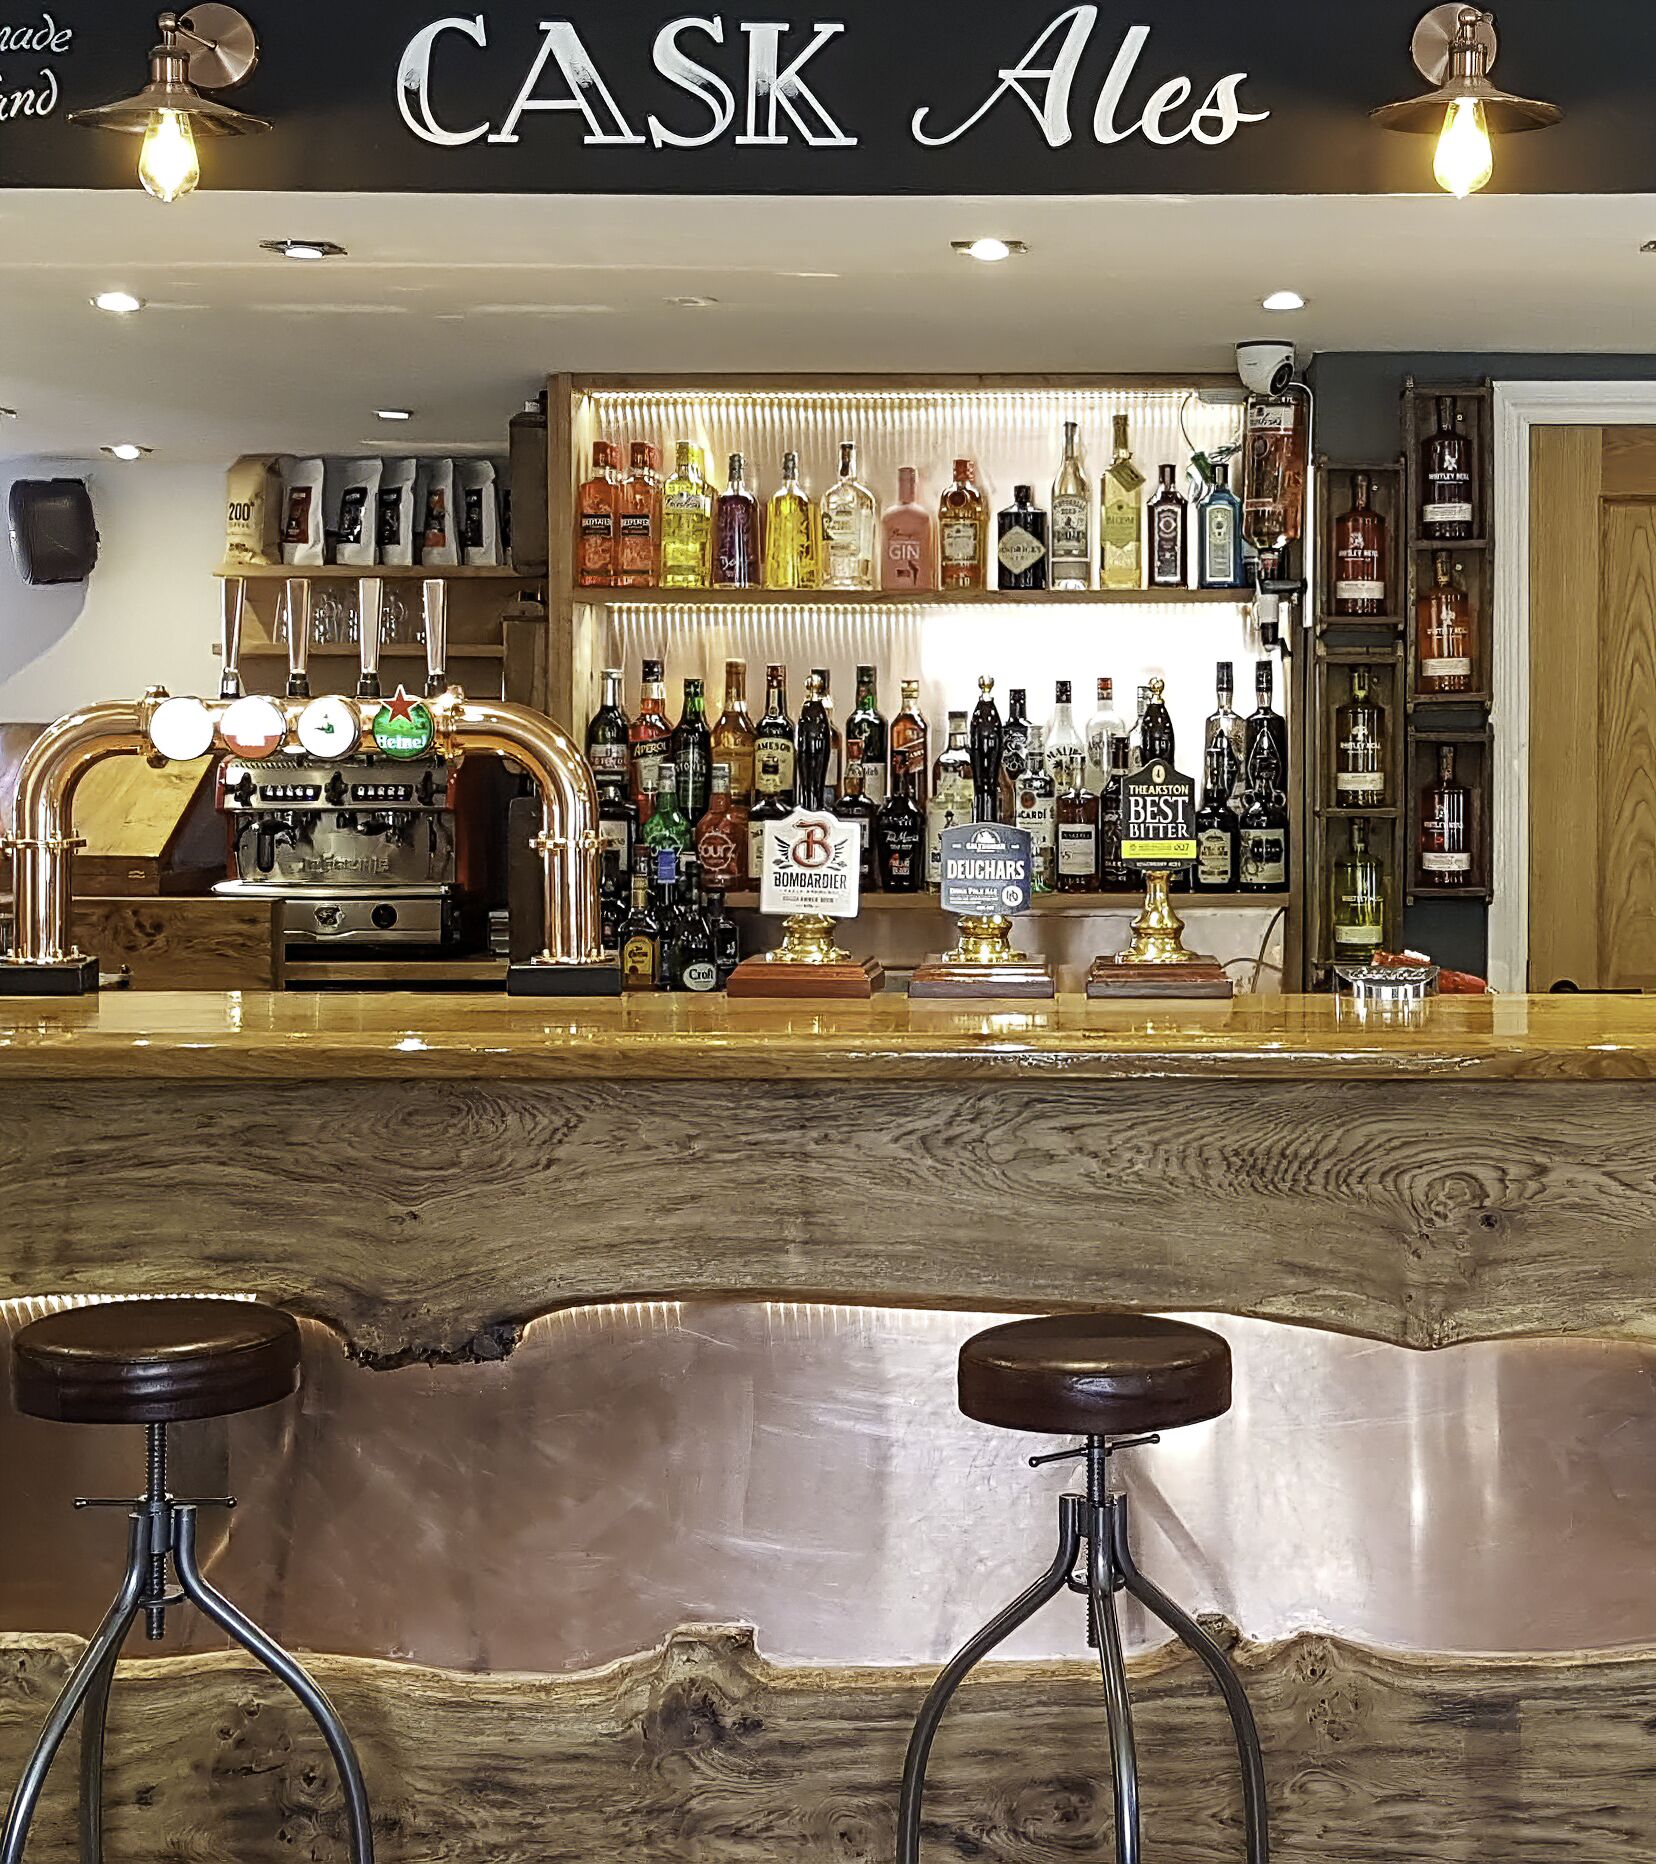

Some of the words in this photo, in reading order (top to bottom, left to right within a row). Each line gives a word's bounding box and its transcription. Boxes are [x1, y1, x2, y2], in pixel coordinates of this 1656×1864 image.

[398, 14, 859, 149] CASK
[912, 4, 1271, 148] Ales
[890, 544, 920, 560] GIN
[756, 741, 791, 752] AMESON
[1128, 784, 1189, 795] THEAKSTON
[1128, 796, 1189, 824] BEST
[1129, 823, 1190, 838] BITTER
[947, 859, 1025, 880] DEUCHARS
[773, 871, 847, 889] BOMBARDIER
